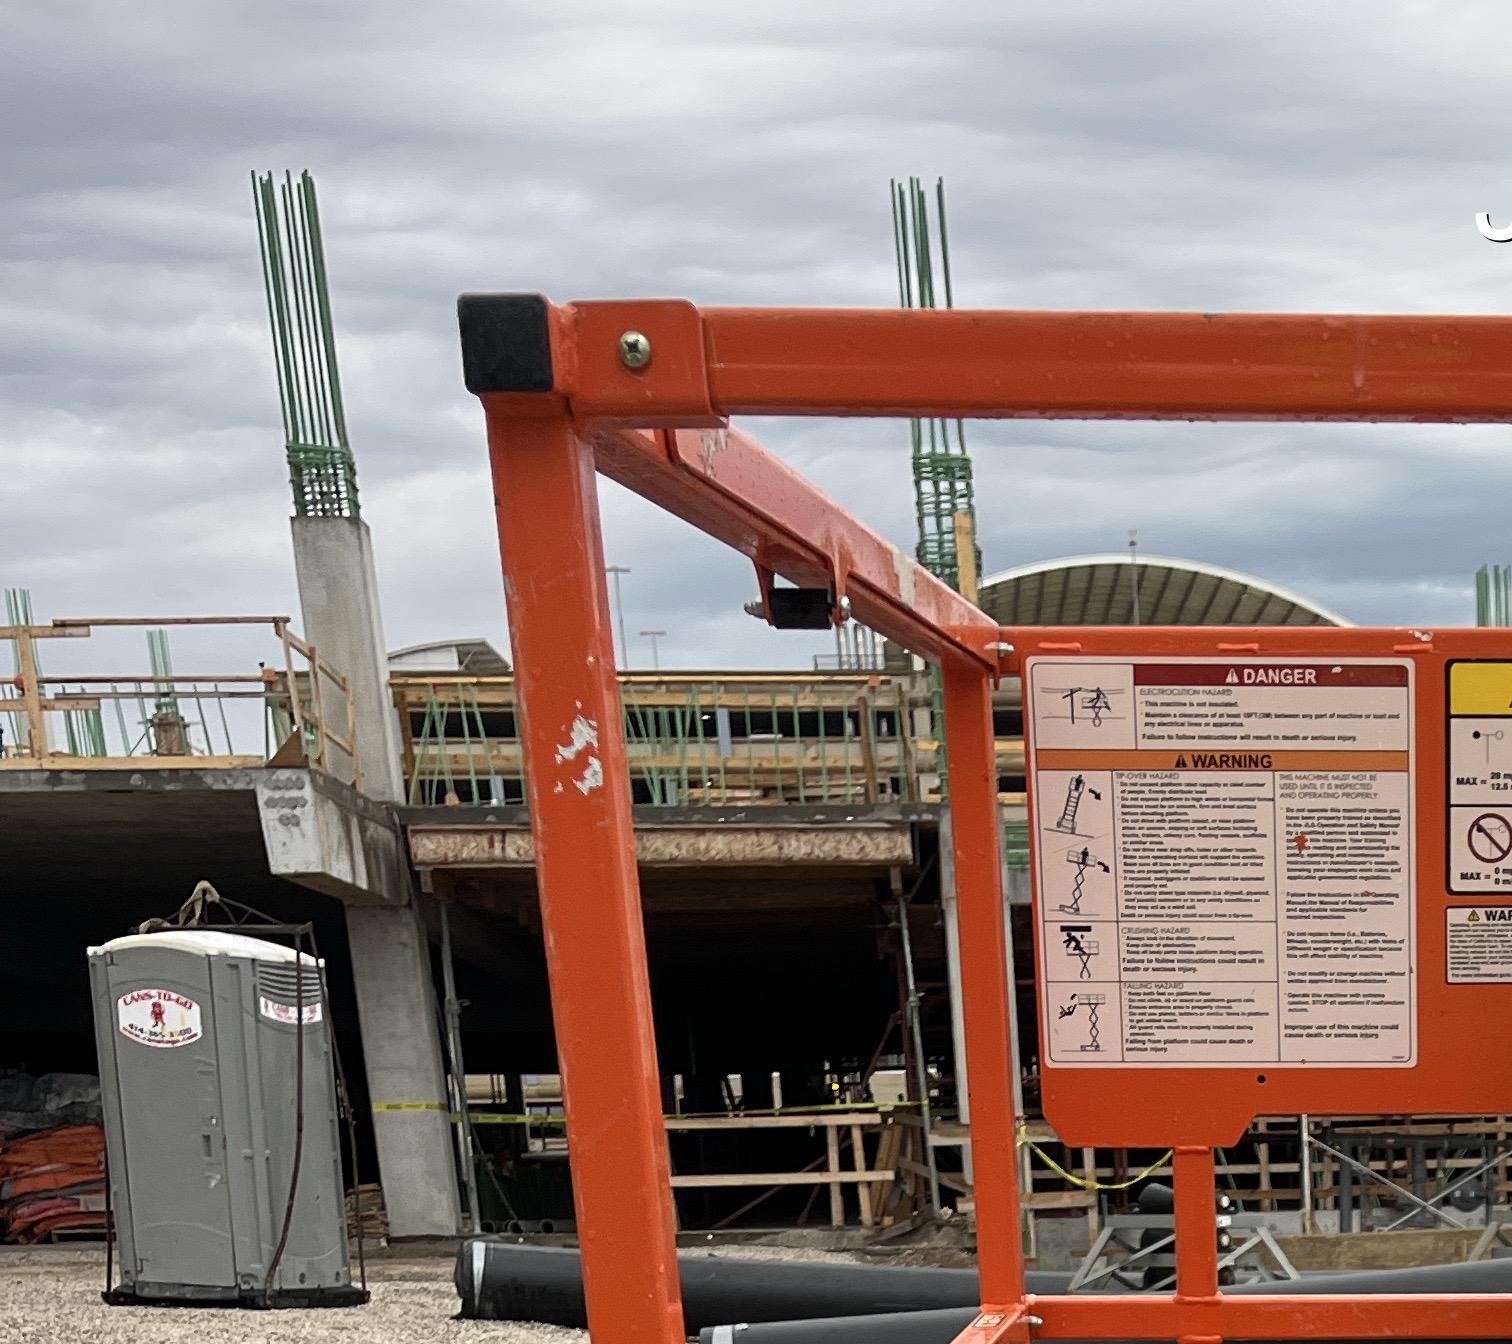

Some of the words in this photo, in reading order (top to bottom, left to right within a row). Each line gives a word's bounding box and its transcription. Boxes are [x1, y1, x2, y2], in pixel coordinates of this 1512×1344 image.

[1243, 668, 1317, 685] DANGER
[1192, 754, 1273, 770] WARNING
[1456, 777, 1478, 785] MAX
[1491, 783, 1508, 791] 12.5
[1460, 872, 1481, 881] MAX
